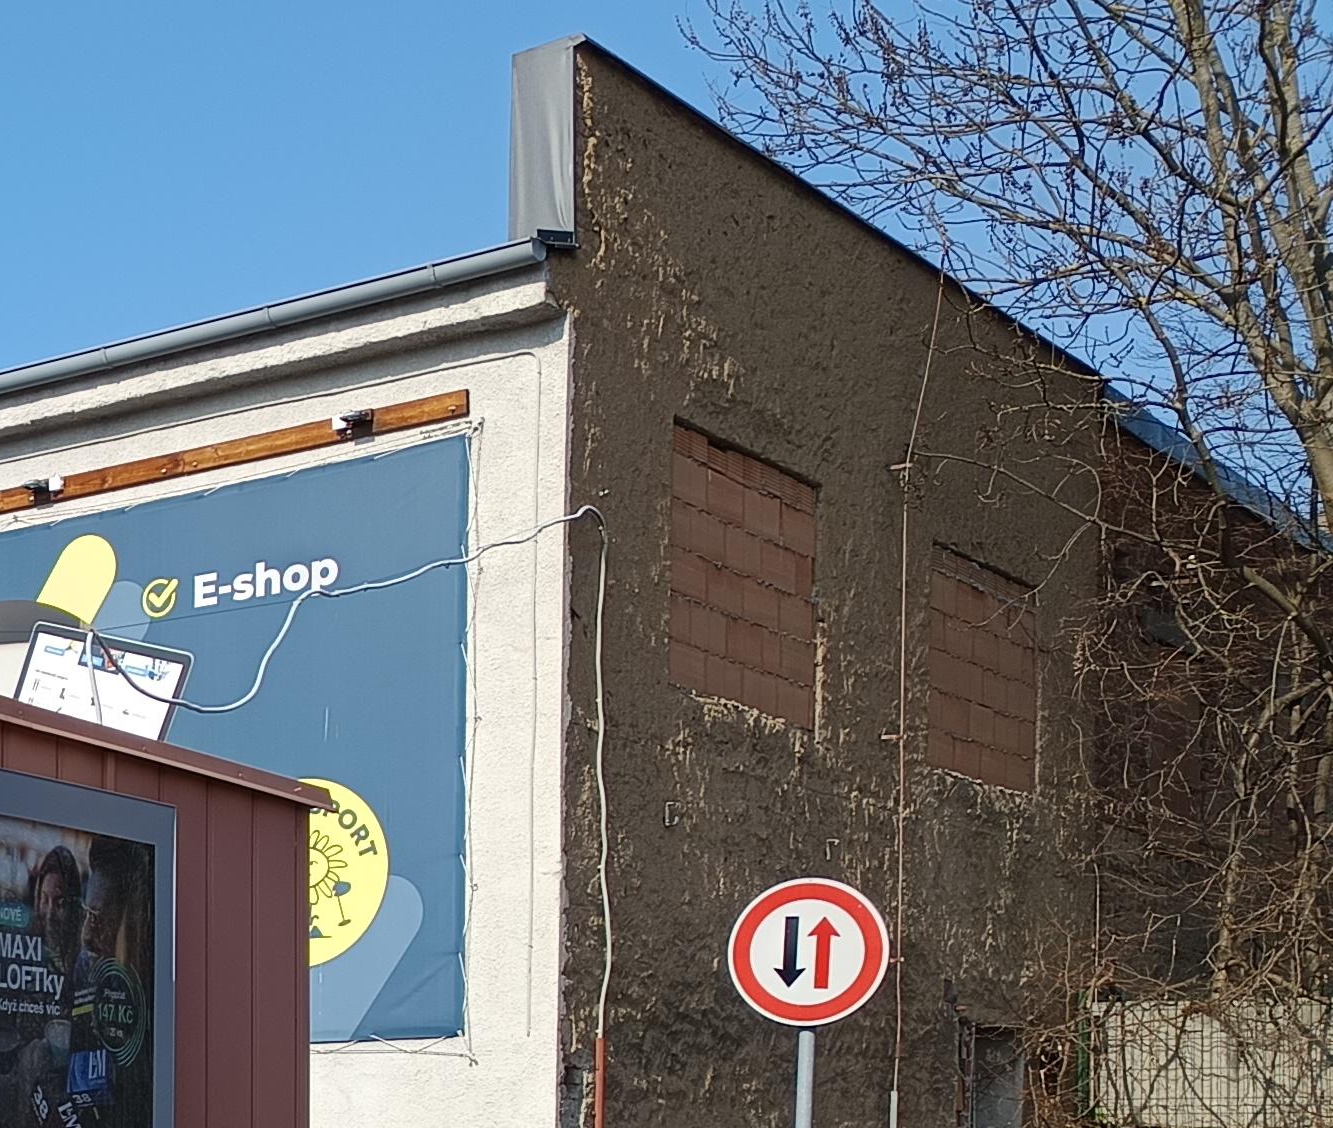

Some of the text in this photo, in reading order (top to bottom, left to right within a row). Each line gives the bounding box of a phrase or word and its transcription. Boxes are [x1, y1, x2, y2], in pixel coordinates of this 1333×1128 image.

[194, 557, 339, 608] E-shop
[19, 1001, 44, 1015] chceš
[46, 1001, 61, 1015] víc
[98, 1003, 133, 1024] 147 Kč
